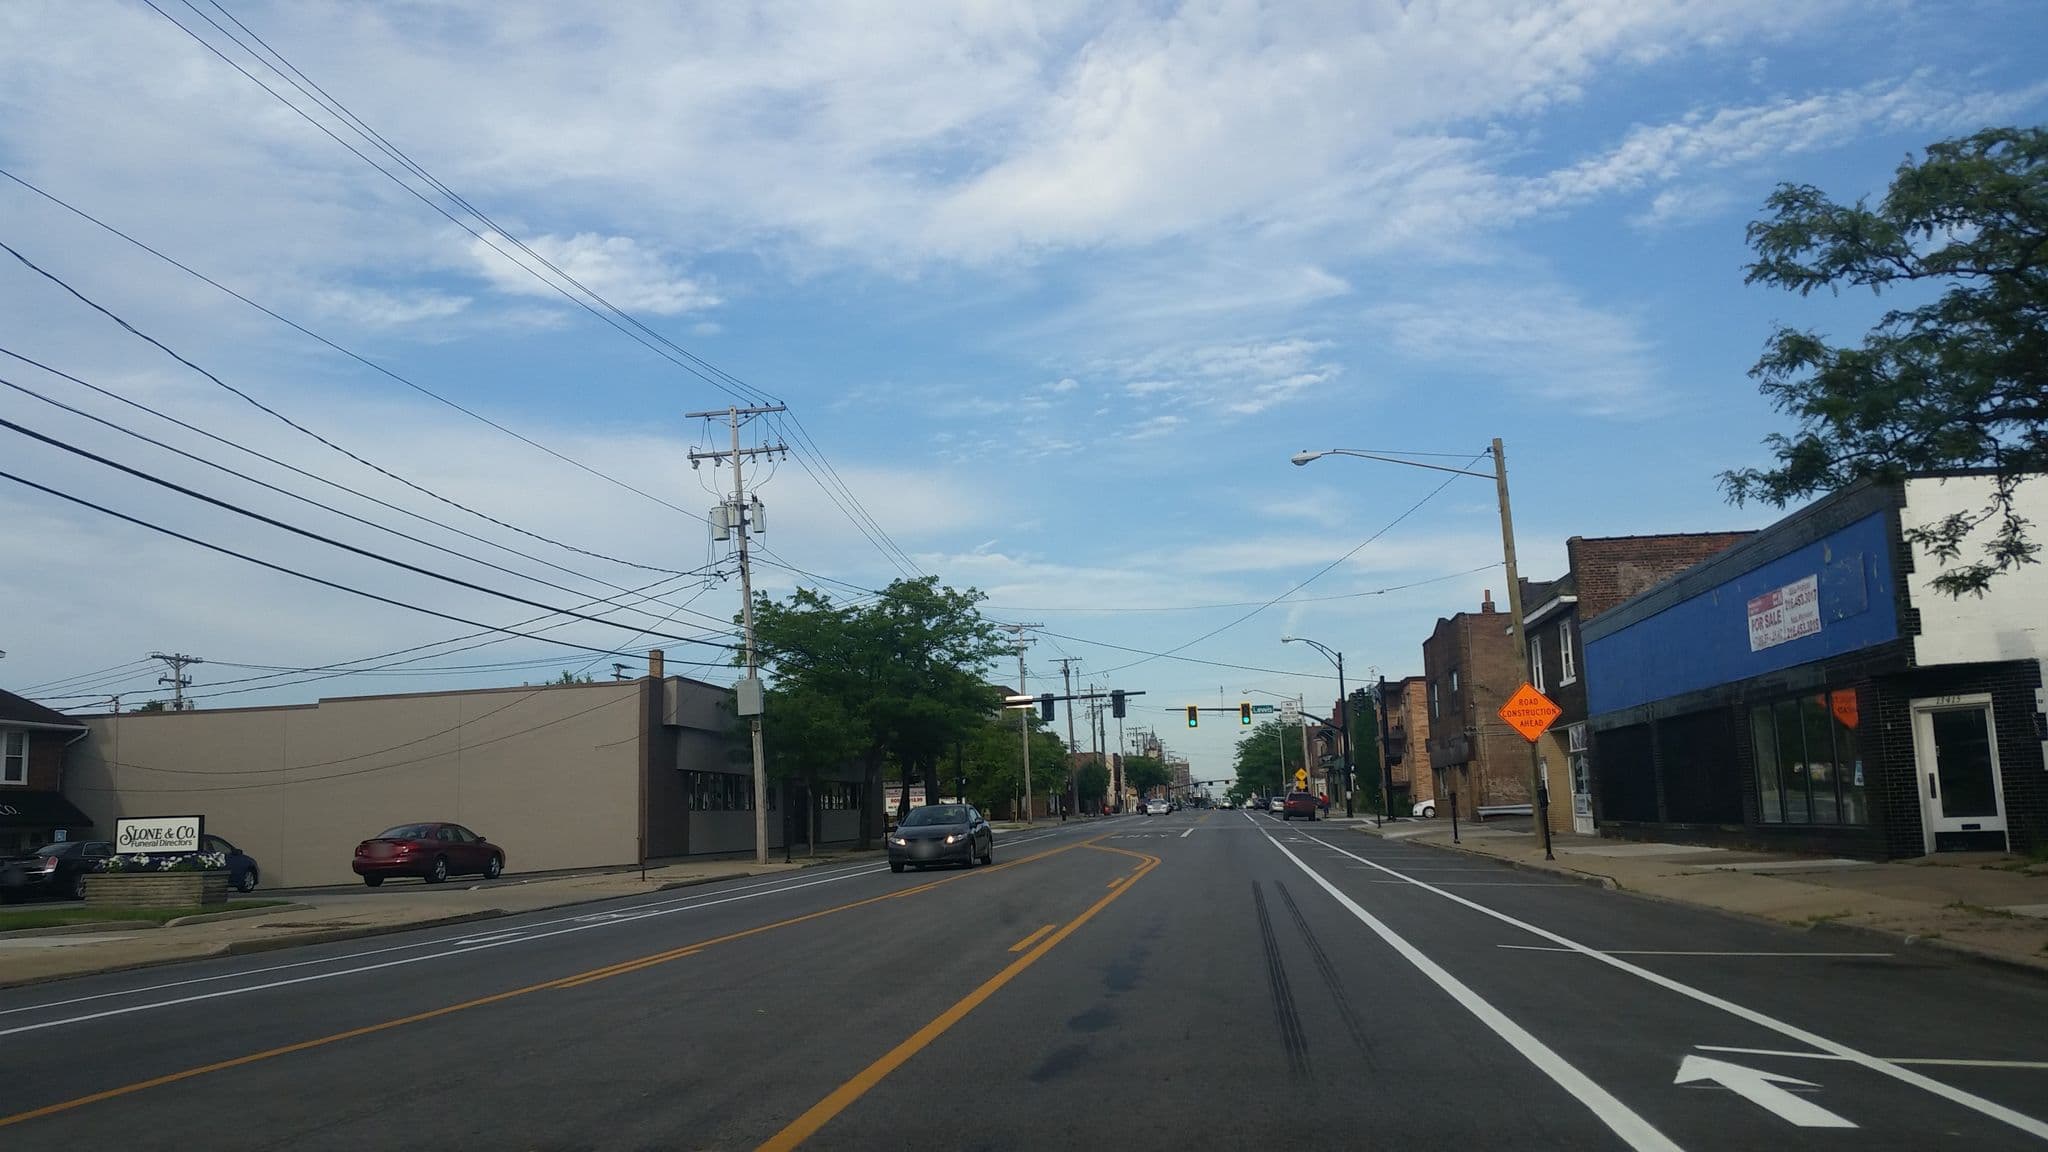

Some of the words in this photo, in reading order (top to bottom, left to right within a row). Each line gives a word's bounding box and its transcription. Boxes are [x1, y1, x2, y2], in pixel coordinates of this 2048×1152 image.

[1751, 616, 1765, 632] FOR
[1764, 609, 1782, 629] SALE
[1518, 698, 1539, 706] ROAD
[1502, 707, 1557, 718] CONSTRUCTION
[1520, 719, 1544, 728] AHEAD
[164, 828, 175, 839] &
[131, 840, 159, 848] Funeral
[159, 838, 192, 847] Directors
